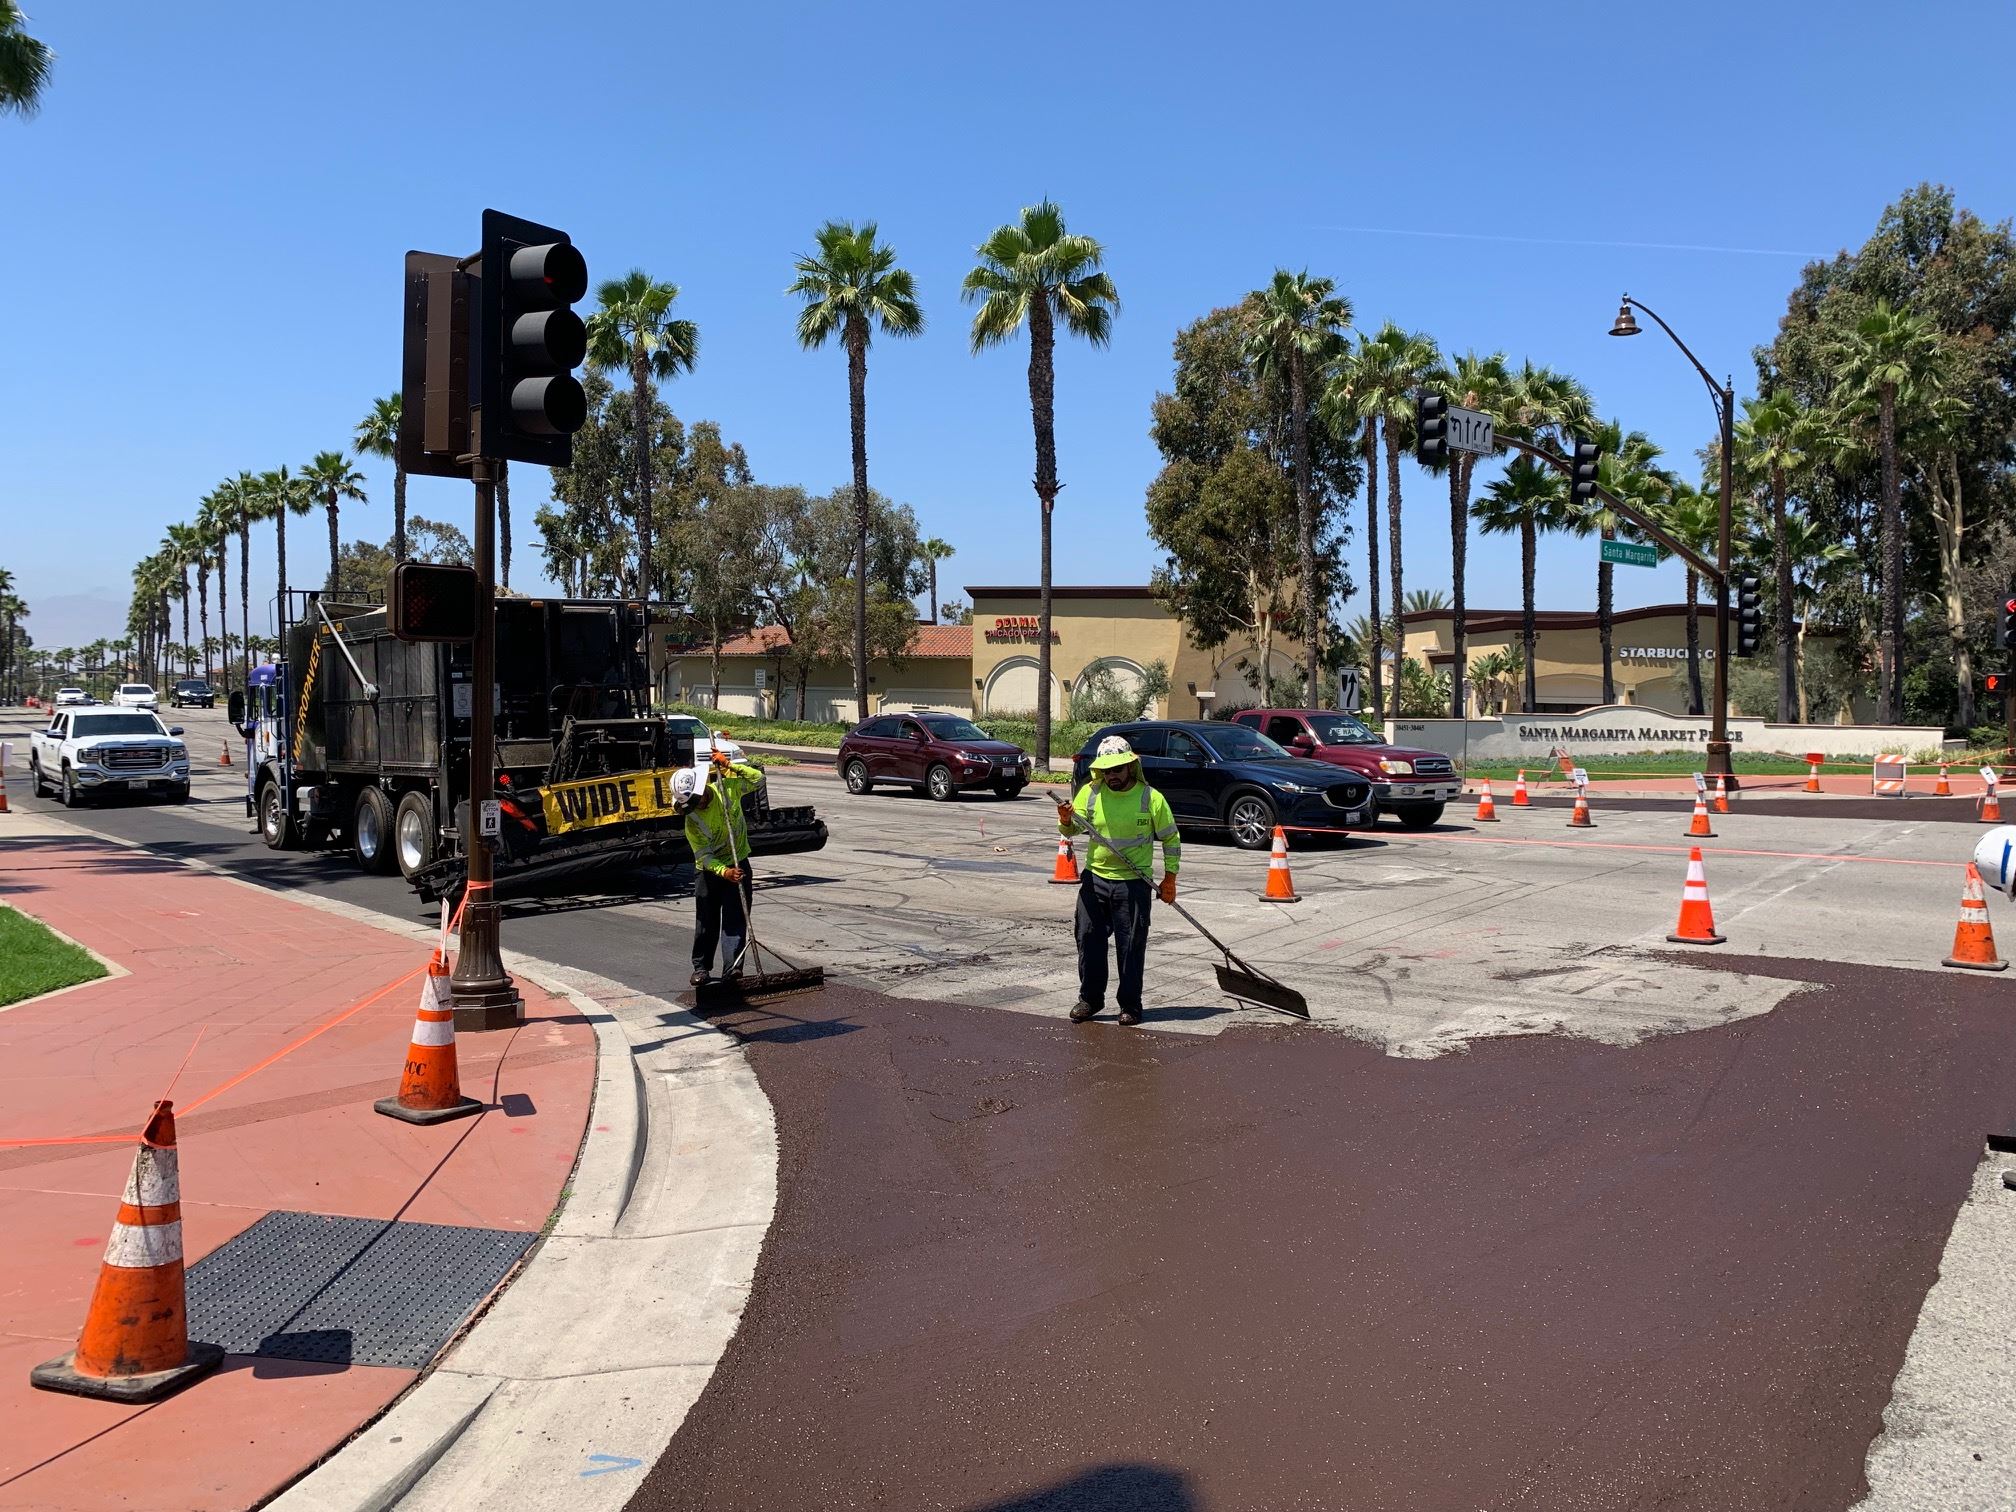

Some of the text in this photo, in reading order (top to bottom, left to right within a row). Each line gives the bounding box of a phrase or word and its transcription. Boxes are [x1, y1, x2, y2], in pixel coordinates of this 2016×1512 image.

[1603, 545, 1655, 564] Santa Margarita
[984, 629, 1020, 637] CHICAGO
[293, 638, 321, 762] MACROPAVER
[1519, 725, 1743, 742] SANTA MARGARITA MARKET PLCE
[554, 779, 639, 823] WIDE
